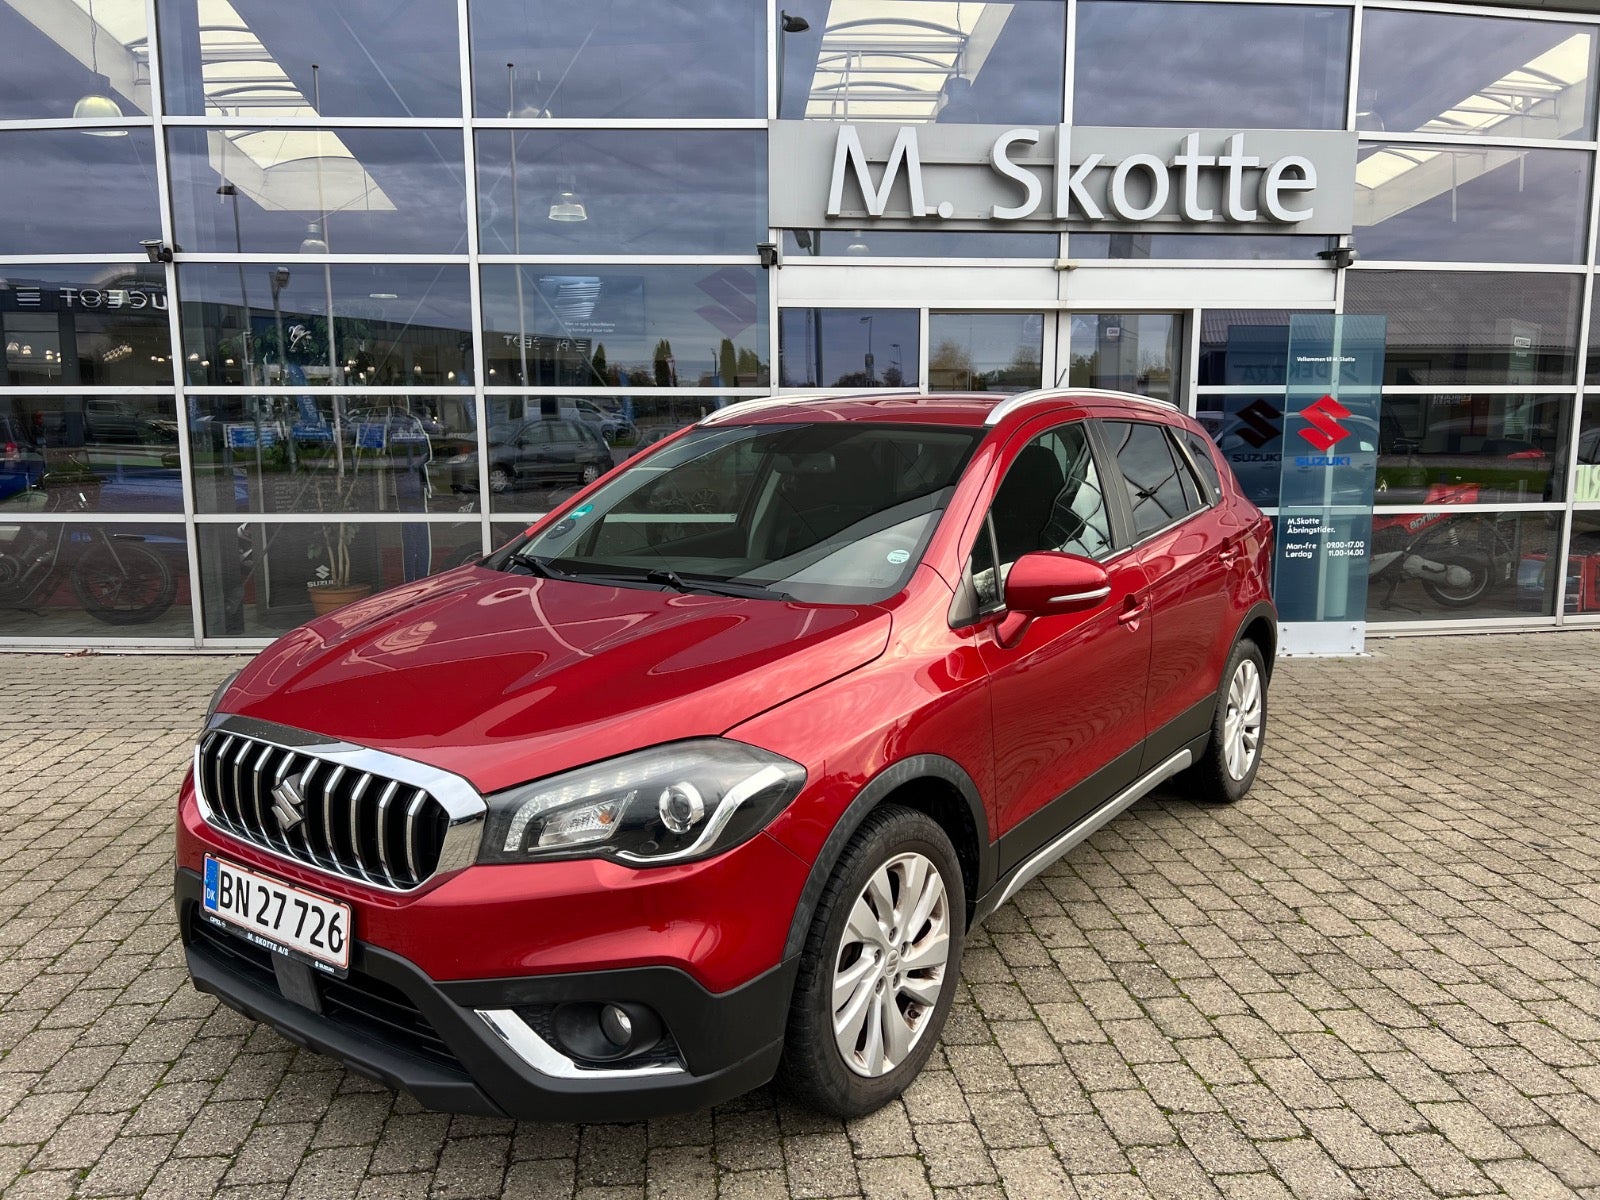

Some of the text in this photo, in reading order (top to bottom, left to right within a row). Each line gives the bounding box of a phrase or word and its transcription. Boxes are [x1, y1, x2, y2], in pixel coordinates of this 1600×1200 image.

[825, 122, 1317, 223] M. Skotte
[1295, 456, 1351, 467] SUZUKI
[1287, 525, 1336, 535] Åbningstider.
[1286, 541, 1317, 550] Man-fre
[1285, 548, 1364, 559] Lørdag 11.00-14.00
[206, 887, 216, 902] DK
[219, 870, 344, 954] BN 27 726
[247, 932, 289, 956] M. SKOTTE A/S
